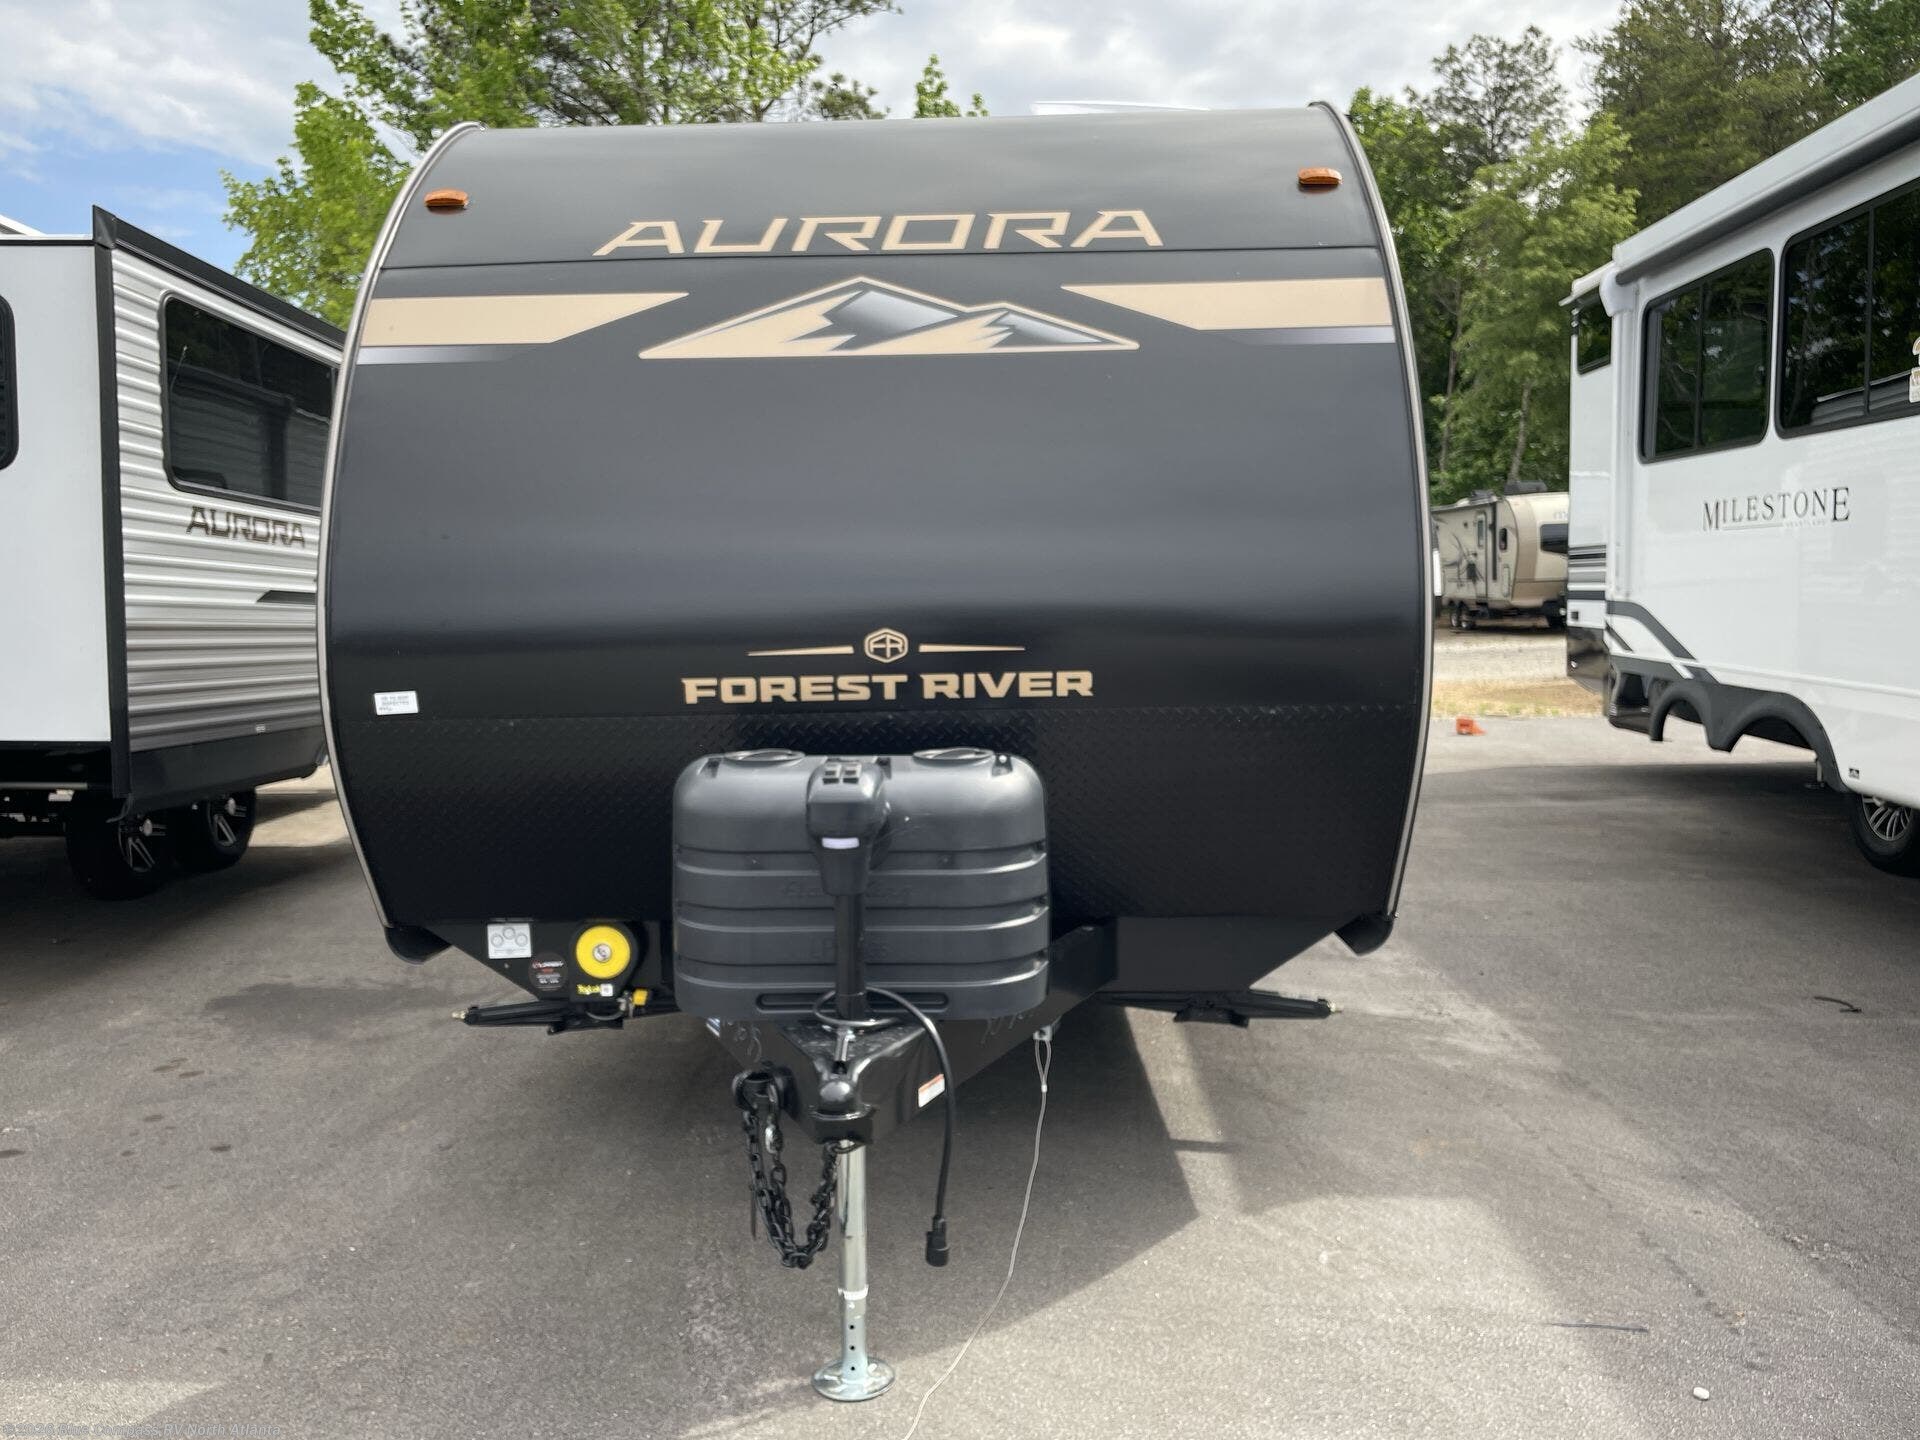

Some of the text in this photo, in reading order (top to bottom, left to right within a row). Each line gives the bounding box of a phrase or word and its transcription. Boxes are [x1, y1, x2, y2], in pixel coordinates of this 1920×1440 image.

[592, 210, 1163, 256] AURORA
[186, 506, 304, 547] AURORA
[1702, 487, 1850, 531] MILESTONE
[681, 670, 1094, 704] FOREST RIVER
